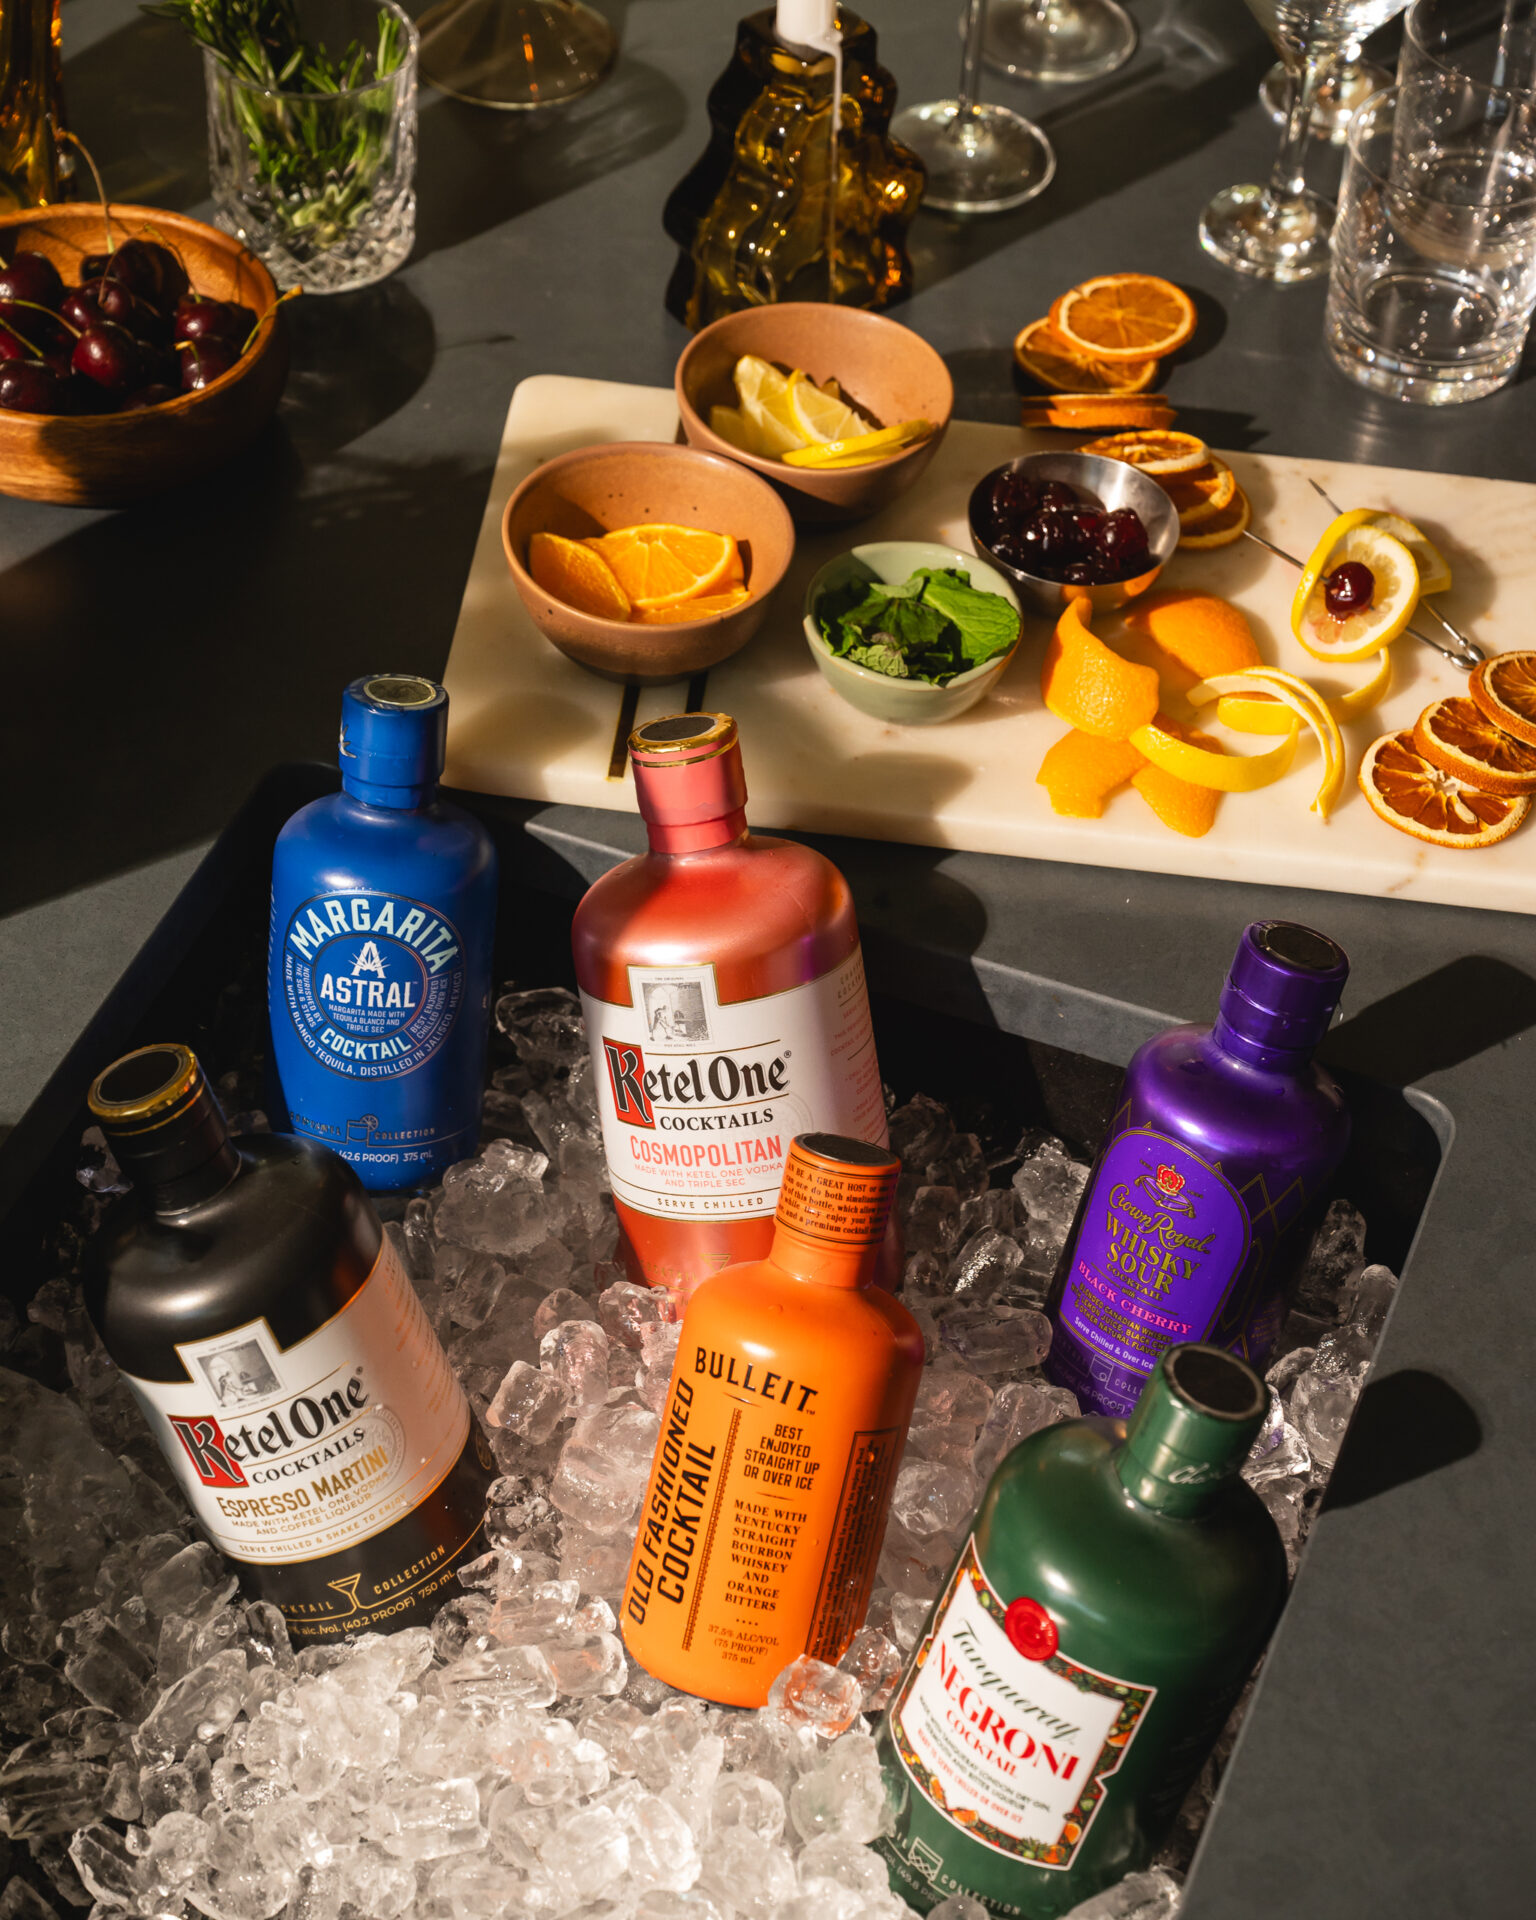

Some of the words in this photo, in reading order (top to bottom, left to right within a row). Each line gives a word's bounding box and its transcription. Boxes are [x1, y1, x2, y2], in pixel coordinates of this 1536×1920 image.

[289, 898, 460, 974] MARGARITA
[285, 954, 293, 982] MADE
[287, 984, 297, 1009] WITH
[303, 966, 317, 1012] NOURISHED
[313, 1012, 323, 1023] BY
[320, 973, 416, 1008] ASTRAL
[301, 1004, 317, 1028] STARS
[328, 1004, 366, 1017] MARGARITA
[367, 1010, 387, 1018] MADE
[332, 1012, 358, 1024] TEQUILA
[359, 1018, 385, 1026] BLANCO
[386, 1018, 400, 1026] AND
[410, 1015, 425, 1034] BEST
[424, 980, 440, 1014] ENJOYED
[416, 1011, 439, 1039] CHILLED
[437, 991, 446, 1010] OVER
[292, 1011, 316, 1048] BLANCO
[346, 1023, 369, 1033] TRIPLE
[371, 1026, 385, 1034] SEC
[320, 1027, 412, 1060] COCKTAIL
[413, 1050, 425, 1061] IN
[360, 1057, 413, 1076] DISTILLED
[604, 1043, 707, 1125] Ketel
[659, 1107, 774, 1131] COCKTAILS
[374, 1127, 436, 1141] COLLECTION
[362, 1153, 399, 1165] PROOF)
[402, 1152, 419, 1162] 375
[420, 1150, 433, 1160] mL
[629, 1134, 783, 1168] COSMOPOLITAN
[634, 1163, 657, 1175] MADE
[658, 1169, 684, 1179] WITH
[686, 1169, 717, 1179] KETEL
[720, 1168, 743, 1178] ONE
[745, 1162, 784, 1176] VODKA
[665, 1178, 685, 1188] AND
[688, 1179, 723, 1188] TRIPLE
[726, 1178, 746, 1187] SEC
[796, 1168, 805, 1179] BE
[806, 1173, 813, 1182] A
[817, 1176, 845, 1190] GREAT
[847, 1182, 868, 1193] HOST
[657, 1198, 695, 1209] SERVE
[704, 1197, 764, 1209] CHILLED
[794, 1188, 807, 1202] this
[837, 1204, 859, 1214] which
[825, 1190, 843, 1201] both
[1109, 1183, 1153, 1227] Crown
[805, 1218, 841, 1233] premium
[826, 1212, 847, 1224] enjoy
[1106, 1209, 1201, 1280] WHISKY
[1106, 1242, 1173, 1295] SOUR
[1106, 1263, 1162, 1301] COCKTAIL
[1078, 1260, 1118, 1304] BLACK
[1120, 1298, 1193, 1335] CHERRY
[1104, 1306, 1141, 1331] CANADIAN
[1074, 1316, 1090, 1334] Serve
[1090, 1328, 1115, 1351] Chilled
[1122, 1350, 1140, 1364] Over
[1141, 1359, 1154, 1370] Ice
[1099, 1321, 1130, 1346] NATURAL
[1125, 1328, 1151, 1345] BLACK
[774, 1423, 804, 1441] BEST
[172, 1411, 295, 1486] Ketel
[252, 1427, 366, 1485] COCKTAILS
[760, 1436, 811, 1459] ENJOYED
[744, 1448, 802, 1473] STRAIGHT
[803, 1461, 820, 1475] UP
[216, 1487, 311, 1518] ESPRESSO
[310, 1444, 389, 1502] MARTINI
[743, 1464, 760, 1480] OR
[762, 1469, 793, 1487] OVER
[795, 1475, 814, 1491] ICE
[231, 1519, 260, 1529] MADE
[261, 1516, 290, 1528] WITH
[291, 1505, 327, 1521] KETEL
[328, 1495, 351, 1510] ONE
[256, 1527, 278, 1536] AND
[280, 1517, 323, 1533] COFFEE
[325, 1492, 372, 1521] LIQUEUR
[628, 1558, 655, 1626] OLD
[643, 1377, 694, 1559] FASHIONED
[734, 1499, 770, 1517] MADE
[774, 1509, 808, 1523] WITH
[239, 1544, 267, 1554] SERVE
[270, 1540, 313, 1553] CHILLED
[326, 1521, 361, 1541] SHAKE
[363, 1513, 376, 1525] TO
[657, 1444, 716, 1605] COCKTAIL
[735, 1513, 801, 1536] KENTUCKY
[732, 1527, 798, 1548] STRAIGHT
[731, 1540, 793, 1561] BOURBON
[373, 1544, 447, 1595] COLLECTION
[731, 1553, 789, 1574] WHISKEY
[727, 1580, 781, 1599] ORANGE
[742, 1570, 770, 1584] AND
[342, 1615, 371, 1633] (40.2
[371, 1596, 416, 1623] PROOF)
[418, 1581, 439, 1600] 750
[439, 1568, 457, 1586] mL
[724, 1592, 777, 1612] BITTERS
[721, 1651, 738, 1662] 375
[740, 1656, 756, 1665] mL
[731, 1641, 769, 1657] PROOF)
[952, 1617, 1081, 1740] Tanqueray
[933, 1639, 1080, 1781] NEGRONI
[946, 1709, 1018, 1778] COCKTAIL
